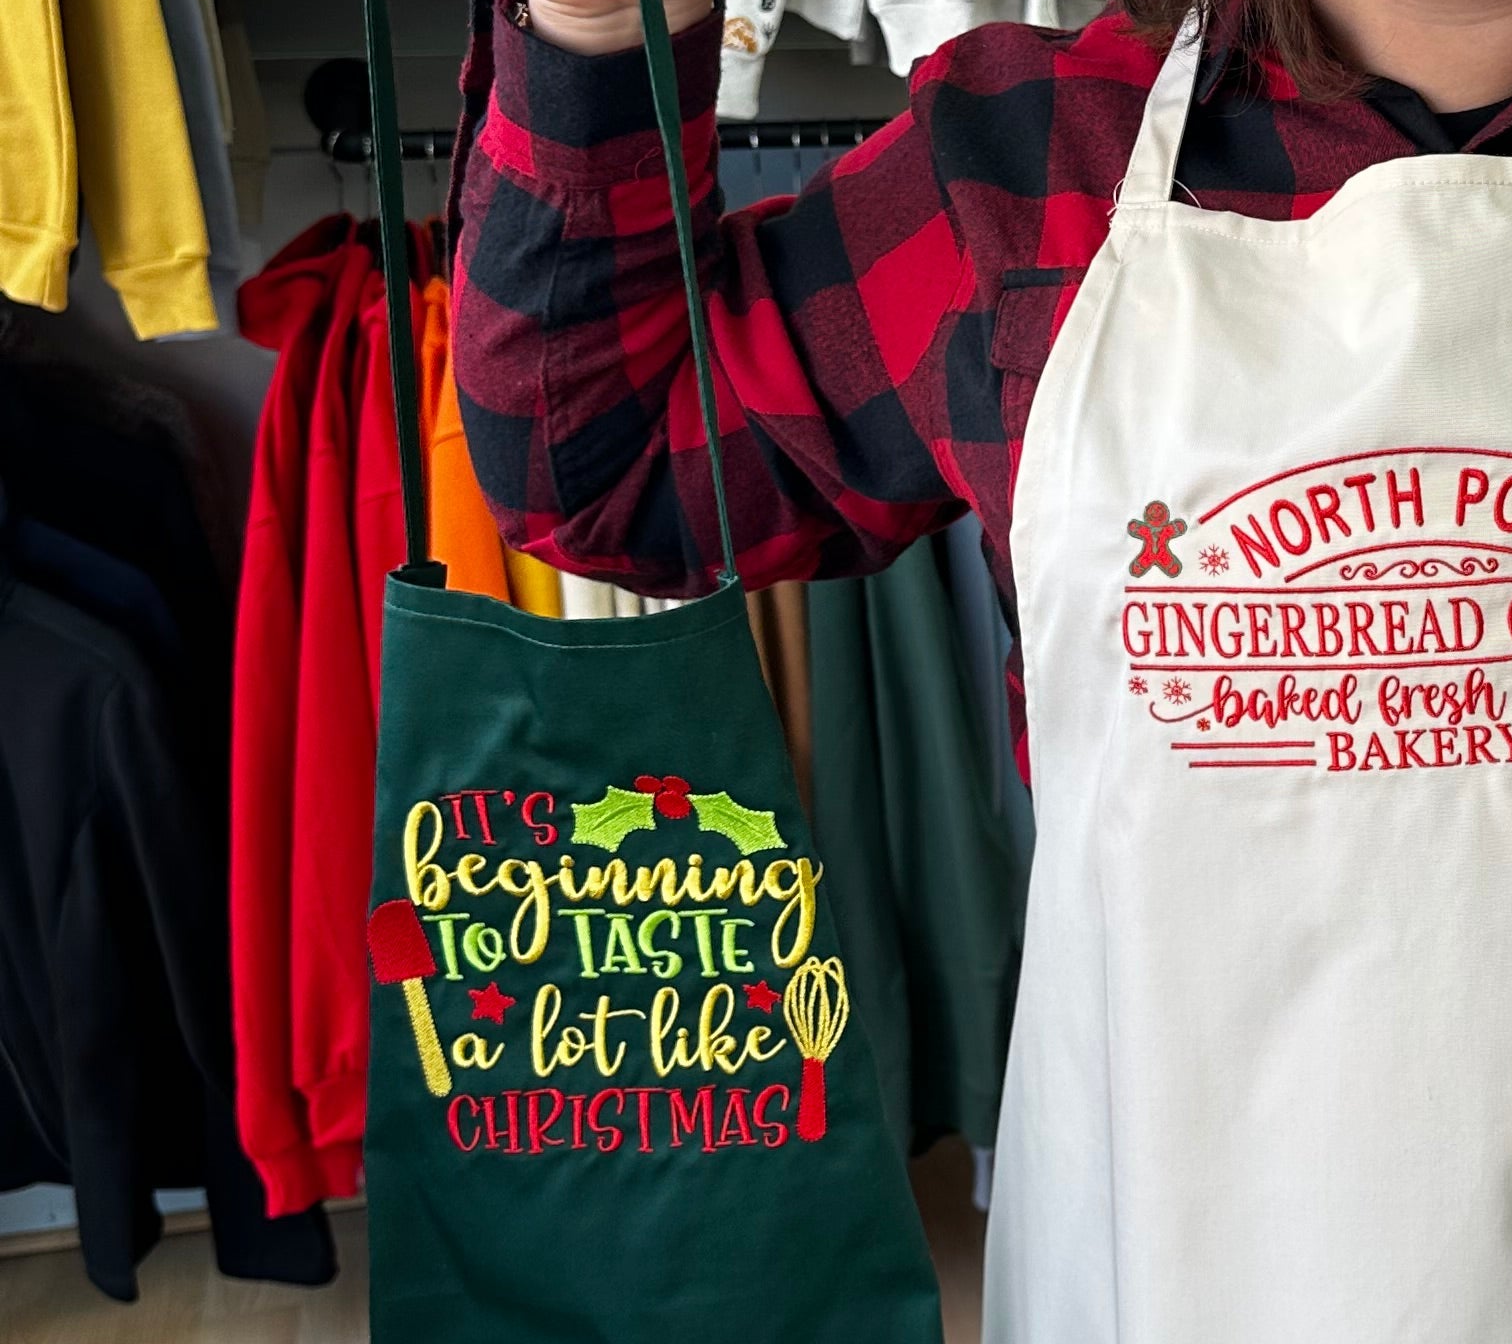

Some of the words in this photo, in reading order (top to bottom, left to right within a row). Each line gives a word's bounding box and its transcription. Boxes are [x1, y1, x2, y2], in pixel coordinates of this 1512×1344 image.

[1230, 467, 1424, 579] NORTH
[1122, 596, 1485, 658] GINGERBREAD
[1212, 666, 1364, 729] baked
[1378, 667, 1507, 730] fresh
[440, 789, 559, 846] IT'S
[403, 800, 824, 968] beginning
[421, 912, 507, 980] TO
[558, 908, 755, 979] TASTE
[452, 1032, 504, 1070] a
[532, 983, 647, 1078] lot
[649, 983, 788, 1079] like
[447, 1084, 792, 1153] CHRISTMAS
